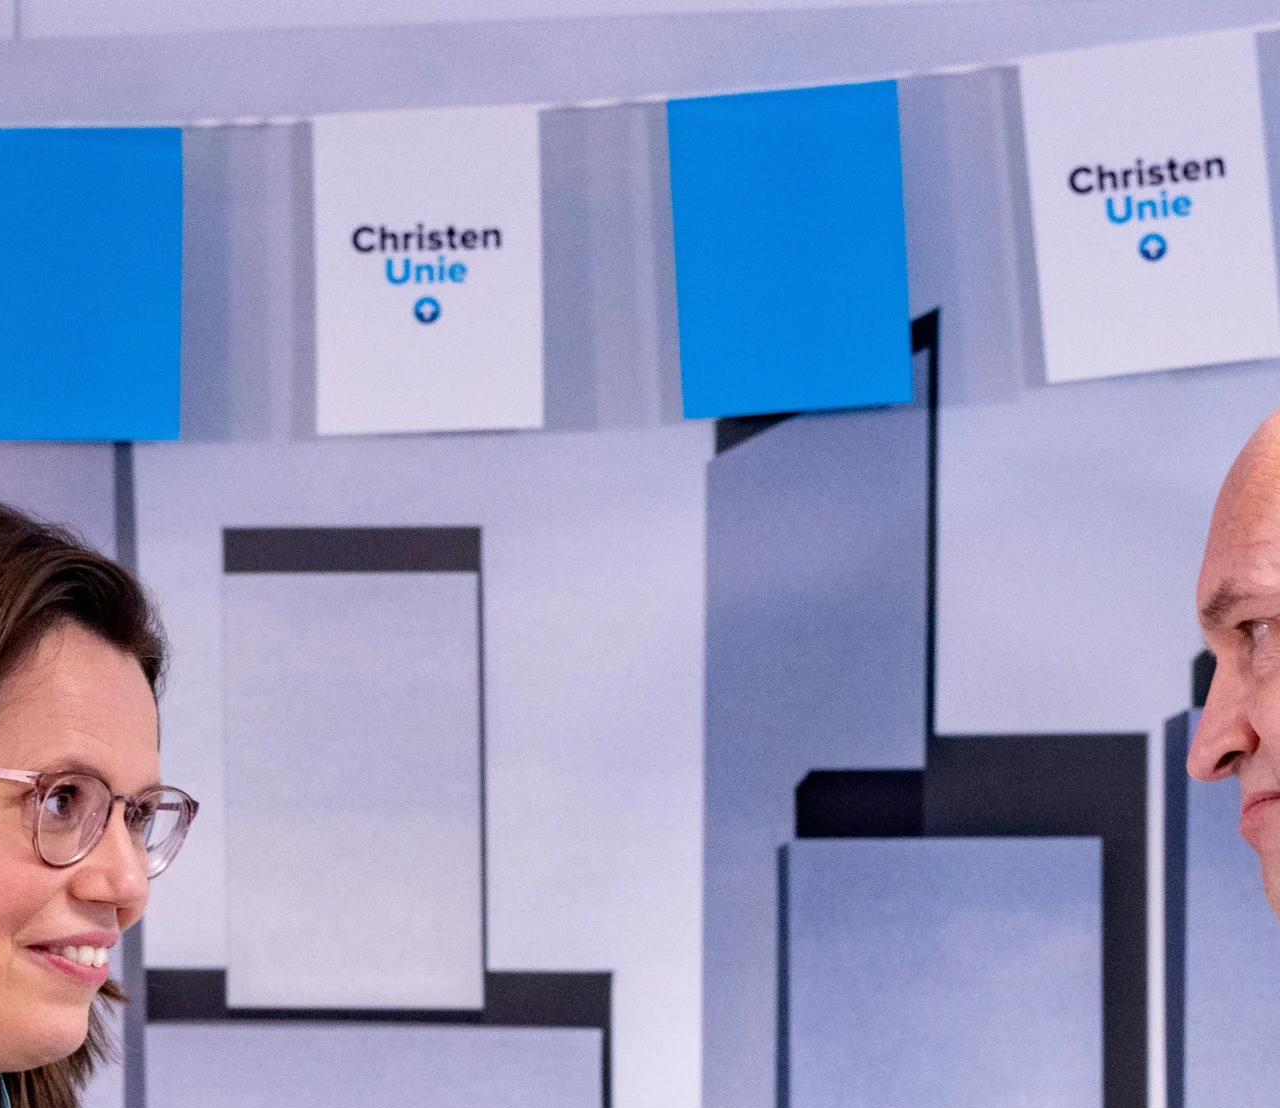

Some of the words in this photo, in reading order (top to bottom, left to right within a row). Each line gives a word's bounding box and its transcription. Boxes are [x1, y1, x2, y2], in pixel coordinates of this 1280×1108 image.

[1068, 156, 1226, 194] Christen
[1105, 188, 1192, 225] Unie
[351, 222, 503, 253] Christen
[385, 255, 468, 286] Unie
